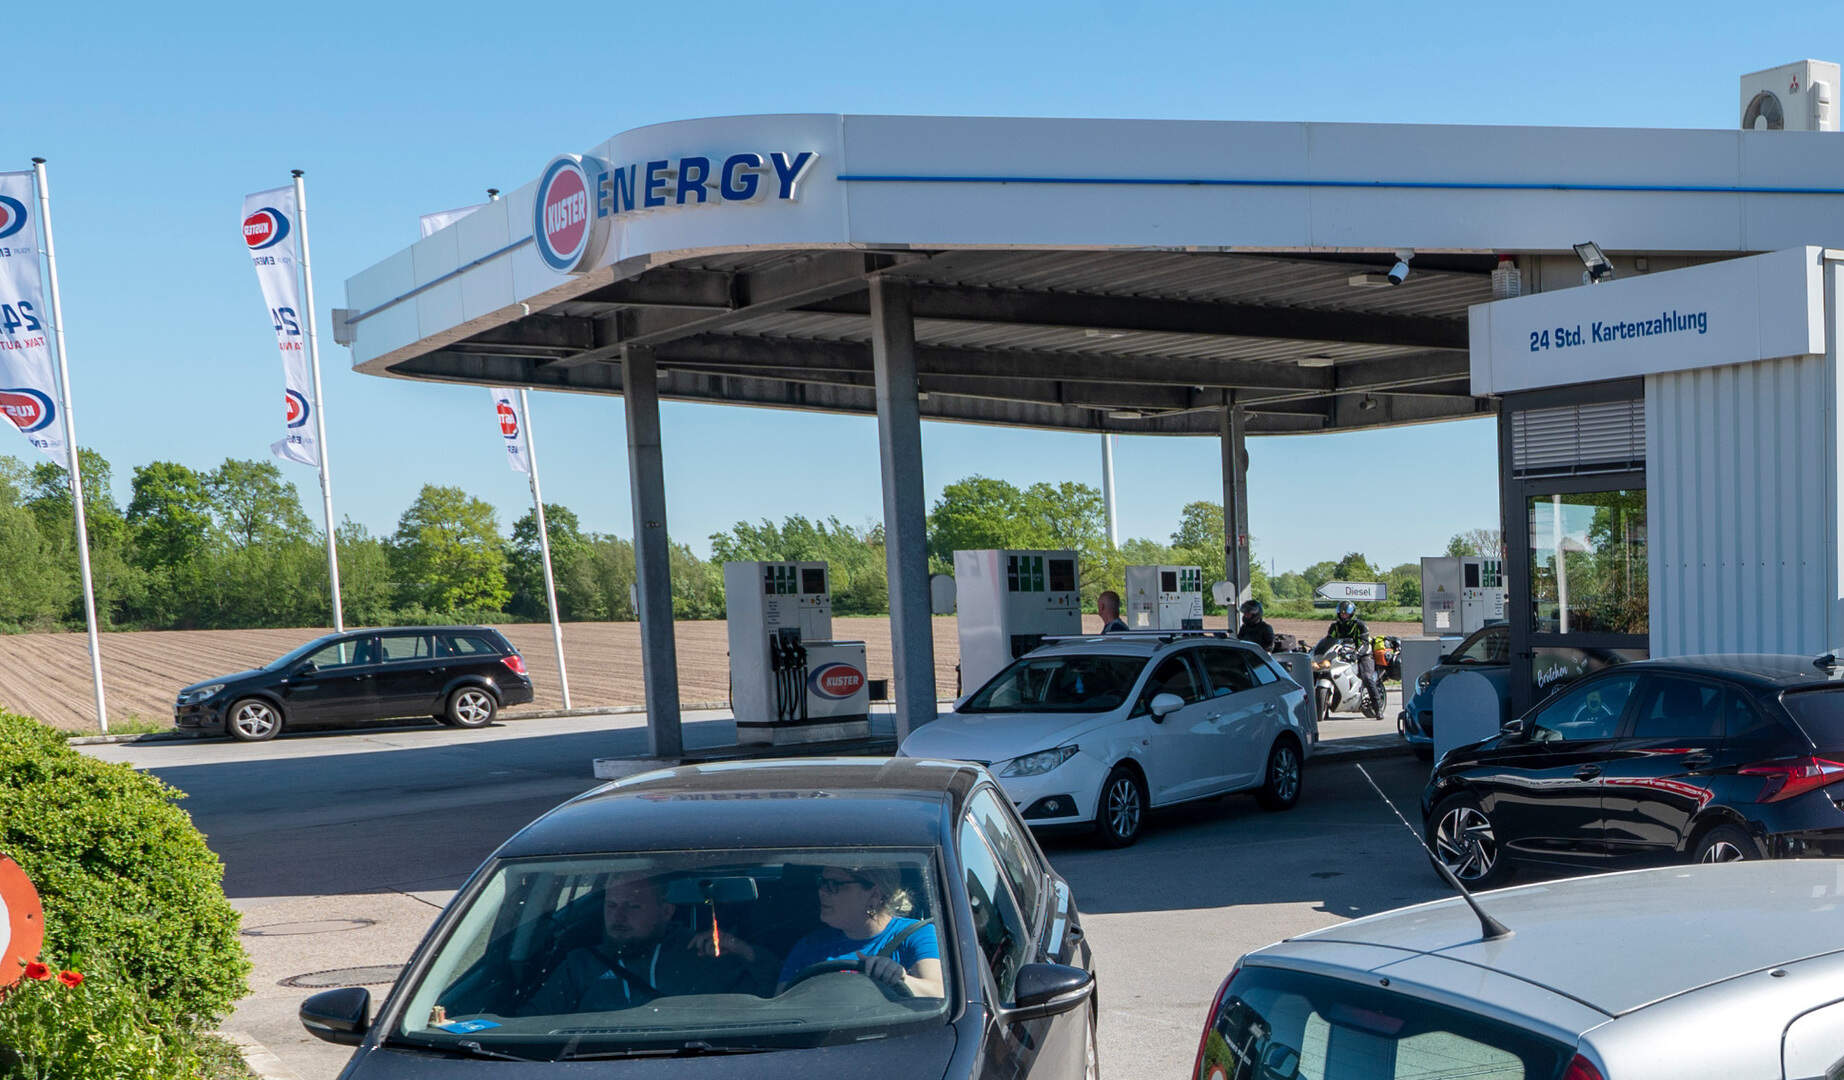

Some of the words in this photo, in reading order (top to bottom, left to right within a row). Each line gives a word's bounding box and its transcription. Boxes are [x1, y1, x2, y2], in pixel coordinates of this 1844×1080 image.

[597, 151, 815, 219] ENERGY
[548, 190, 586, 234] KUSTER
[1530, 330, 1549, 352] 24
[1555, 325, 1585, 348] Std.
[1592, 310, 1707, 343] Kartenzahlung
[815, 595, 822, 606] 5
[1345, 586, 1371, 596] Diesel
[826, 675, 859, 687] KUSTER
